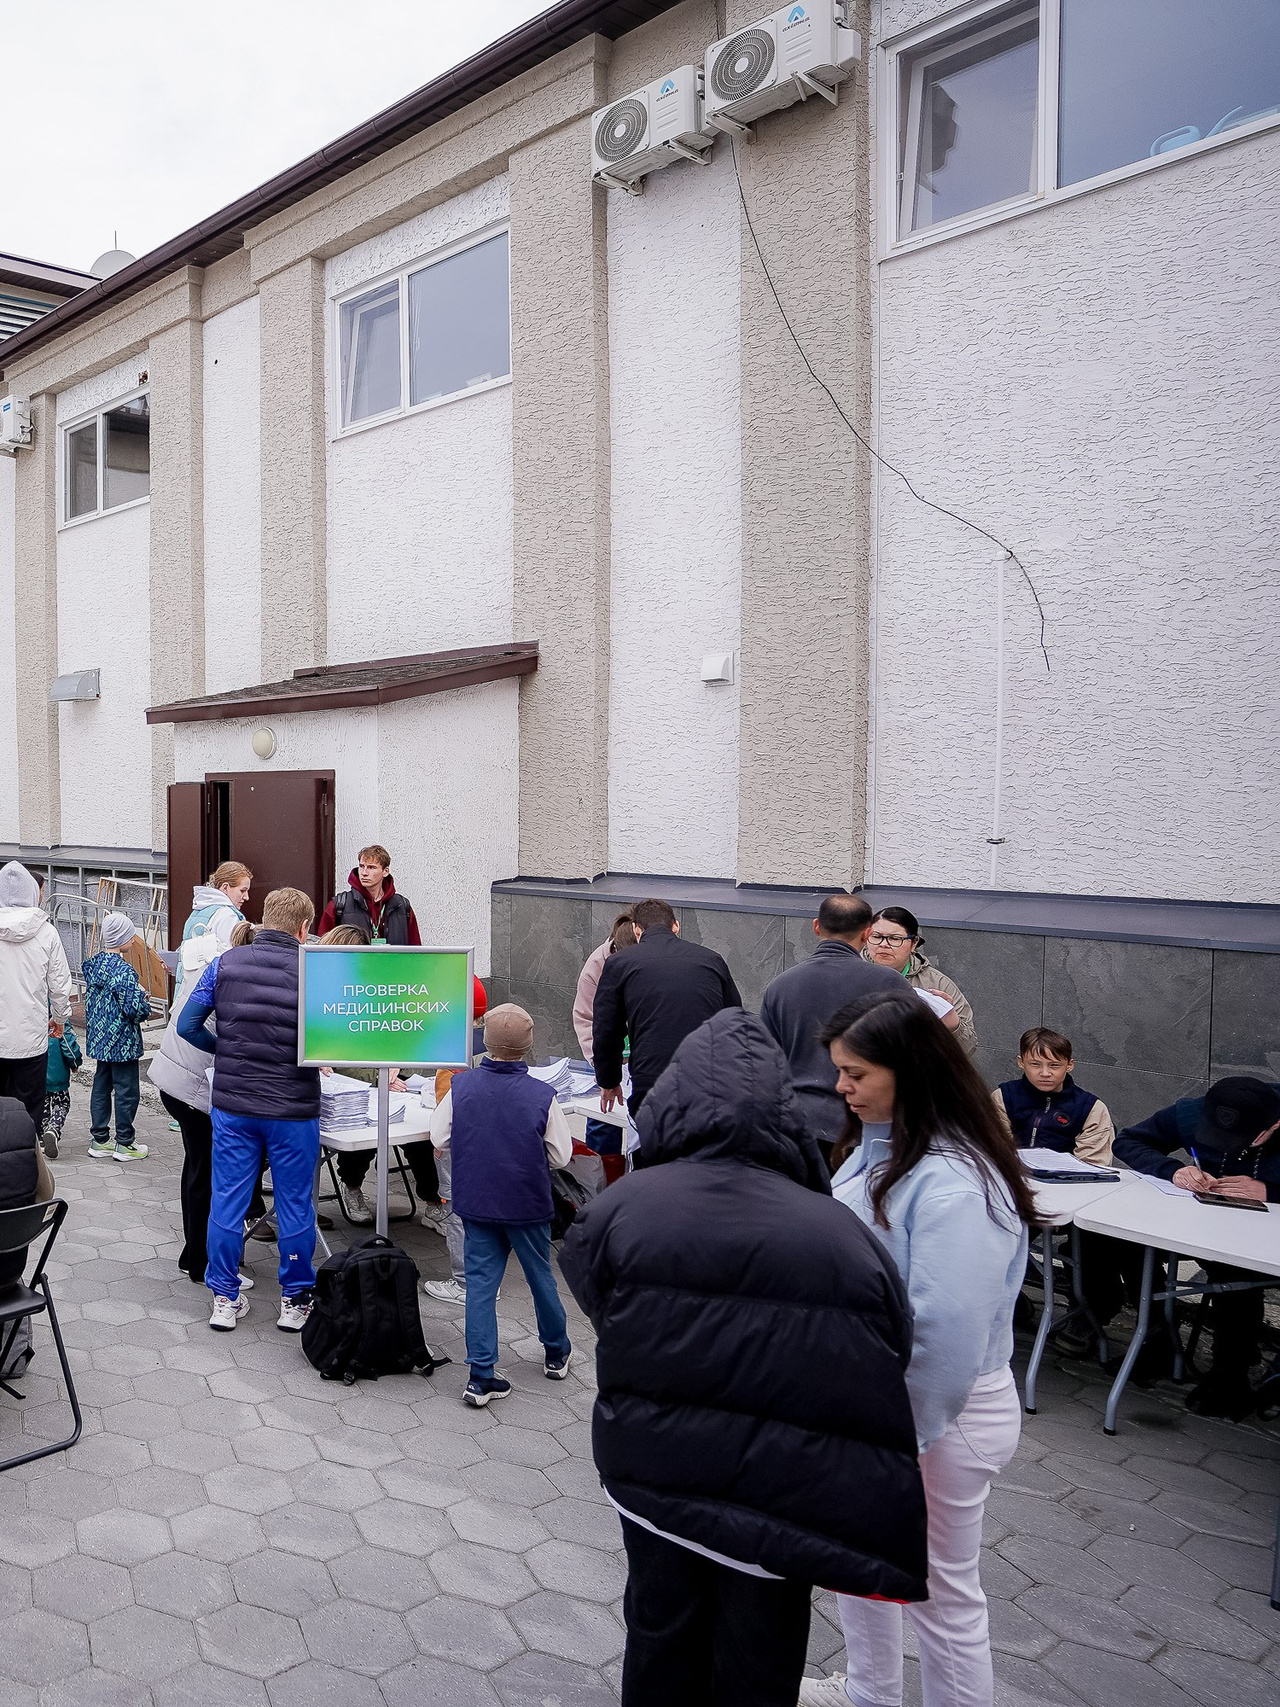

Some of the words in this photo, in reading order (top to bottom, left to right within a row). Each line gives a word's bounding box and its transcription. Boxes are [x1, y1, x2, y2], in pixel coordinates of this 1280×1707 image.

[343, 984, 429, 997] ПРОВЕРКА
[323, 1001, 450, 1016] МЕДИЦИНСКИХ
[348, 1020, 424, 1032] СПРАВОК
